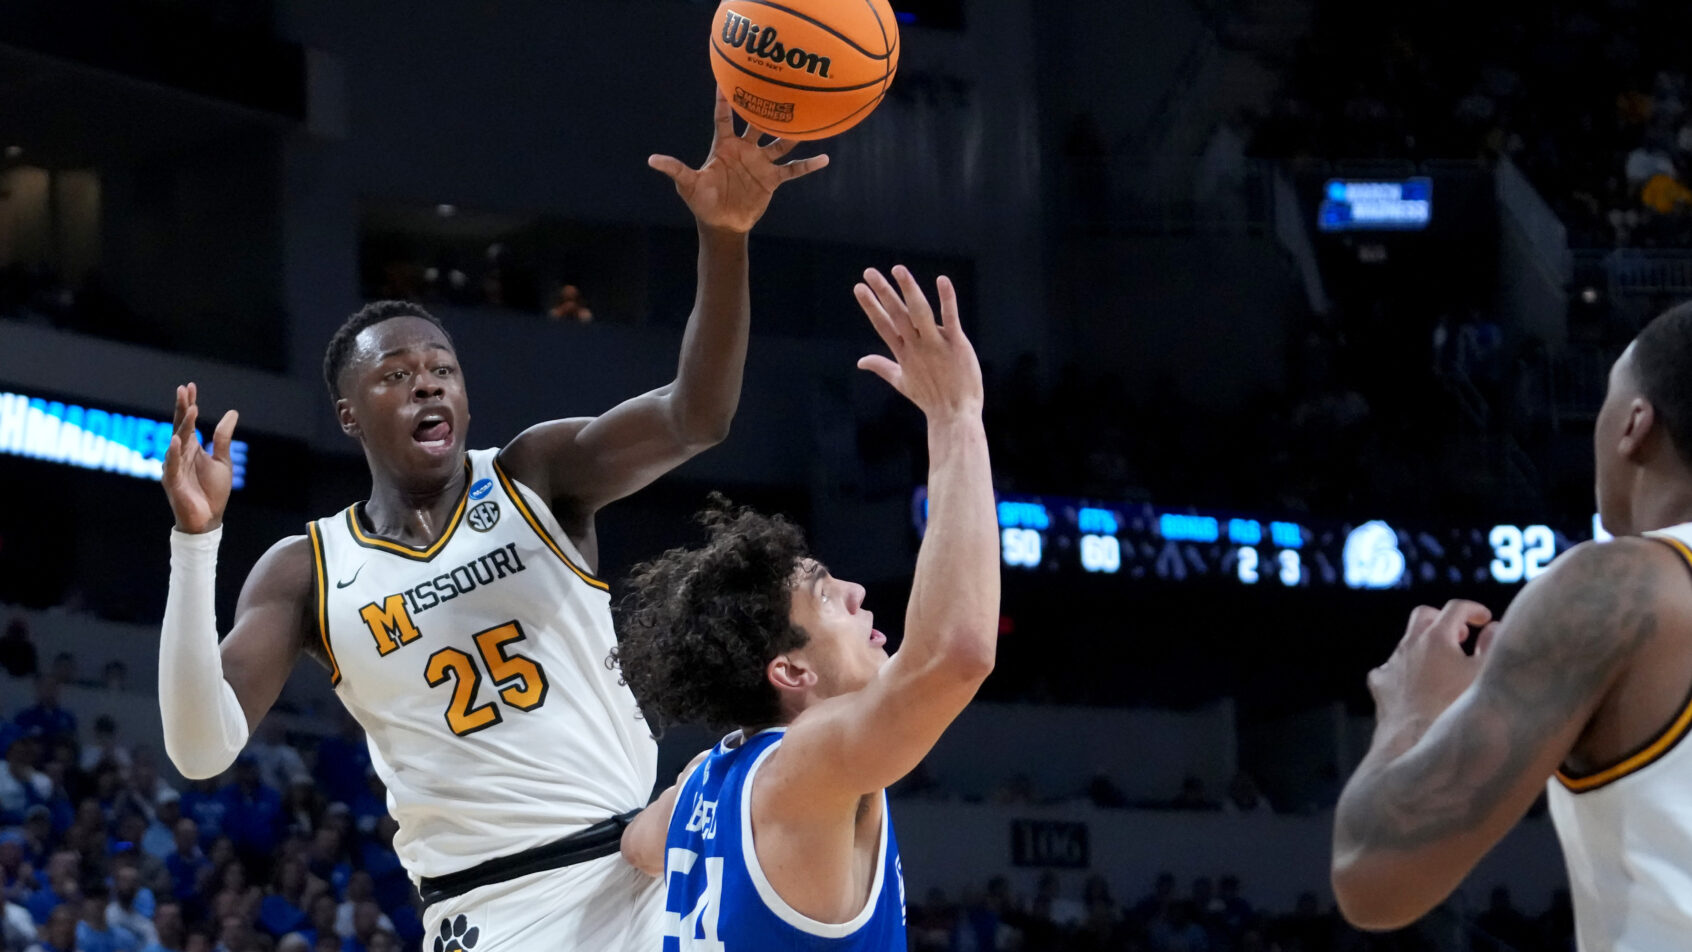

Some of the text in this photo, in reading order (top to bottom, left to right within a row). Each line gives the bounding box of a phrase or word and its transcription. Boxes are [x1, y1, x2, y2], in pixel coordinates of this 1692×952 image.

[722, 9, 831, 78] Wilson
[747, 56, 782, 72] EVO NXT
[744, 92, 776, 111] MARCH
[748, 101, 793, 122] MADNESS
[469, 503, 499, 530] SEC
[1238, 546, 1258, 583] 2
[1489, 524, 1555, 583] 32
[358, 542, 526, 657] MISSOURI
[424, 619, 549, 737] 25
